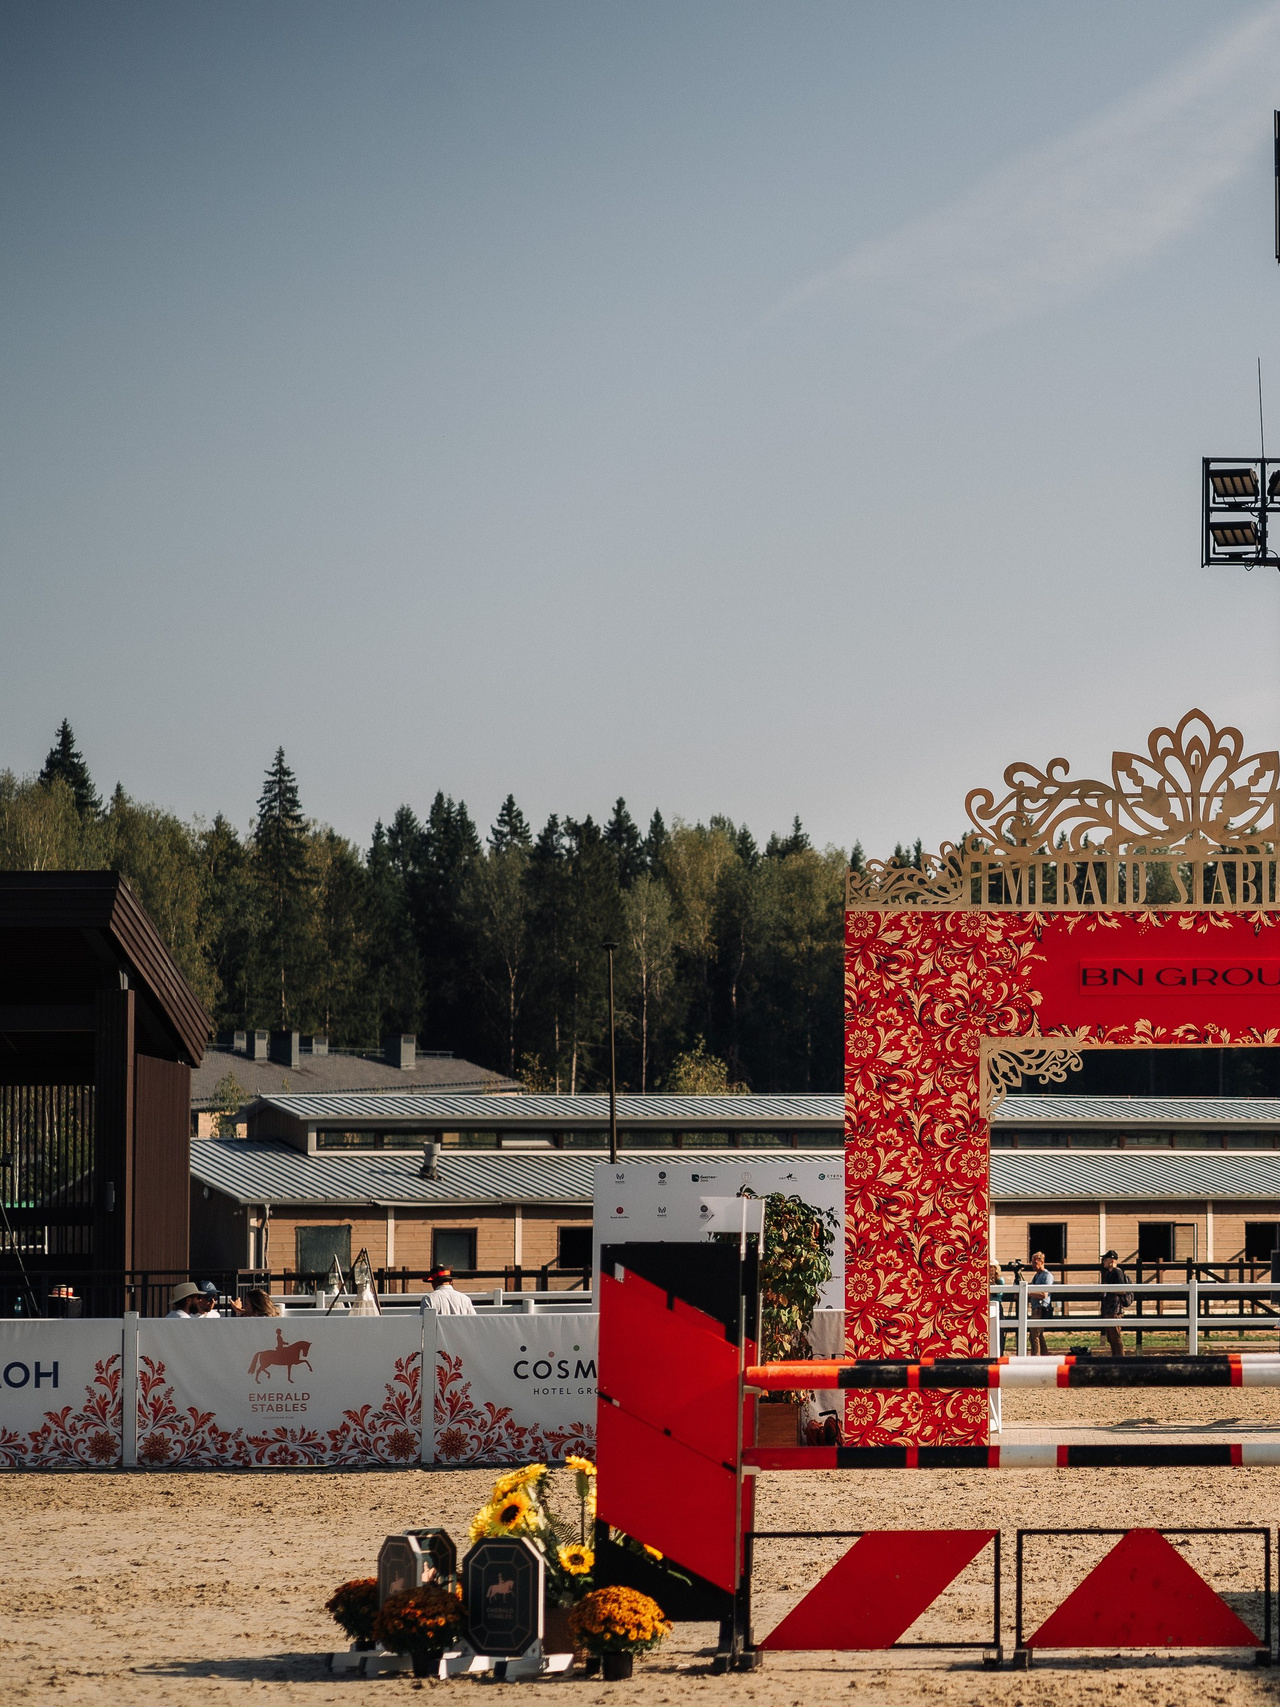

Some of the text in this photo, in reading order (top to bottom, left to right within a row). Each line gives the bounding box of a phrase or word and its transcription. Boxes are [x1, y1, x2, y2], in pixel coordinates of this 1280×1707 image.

[981, 860, 1147, 904] EMERALD
[1081, 967, 1144, 987] BN
[513, 1360, 598, 1379] COSM
[249, 1392, 310, 1402] EMERALD
[251, 1403, 308, 1413] STABLES
